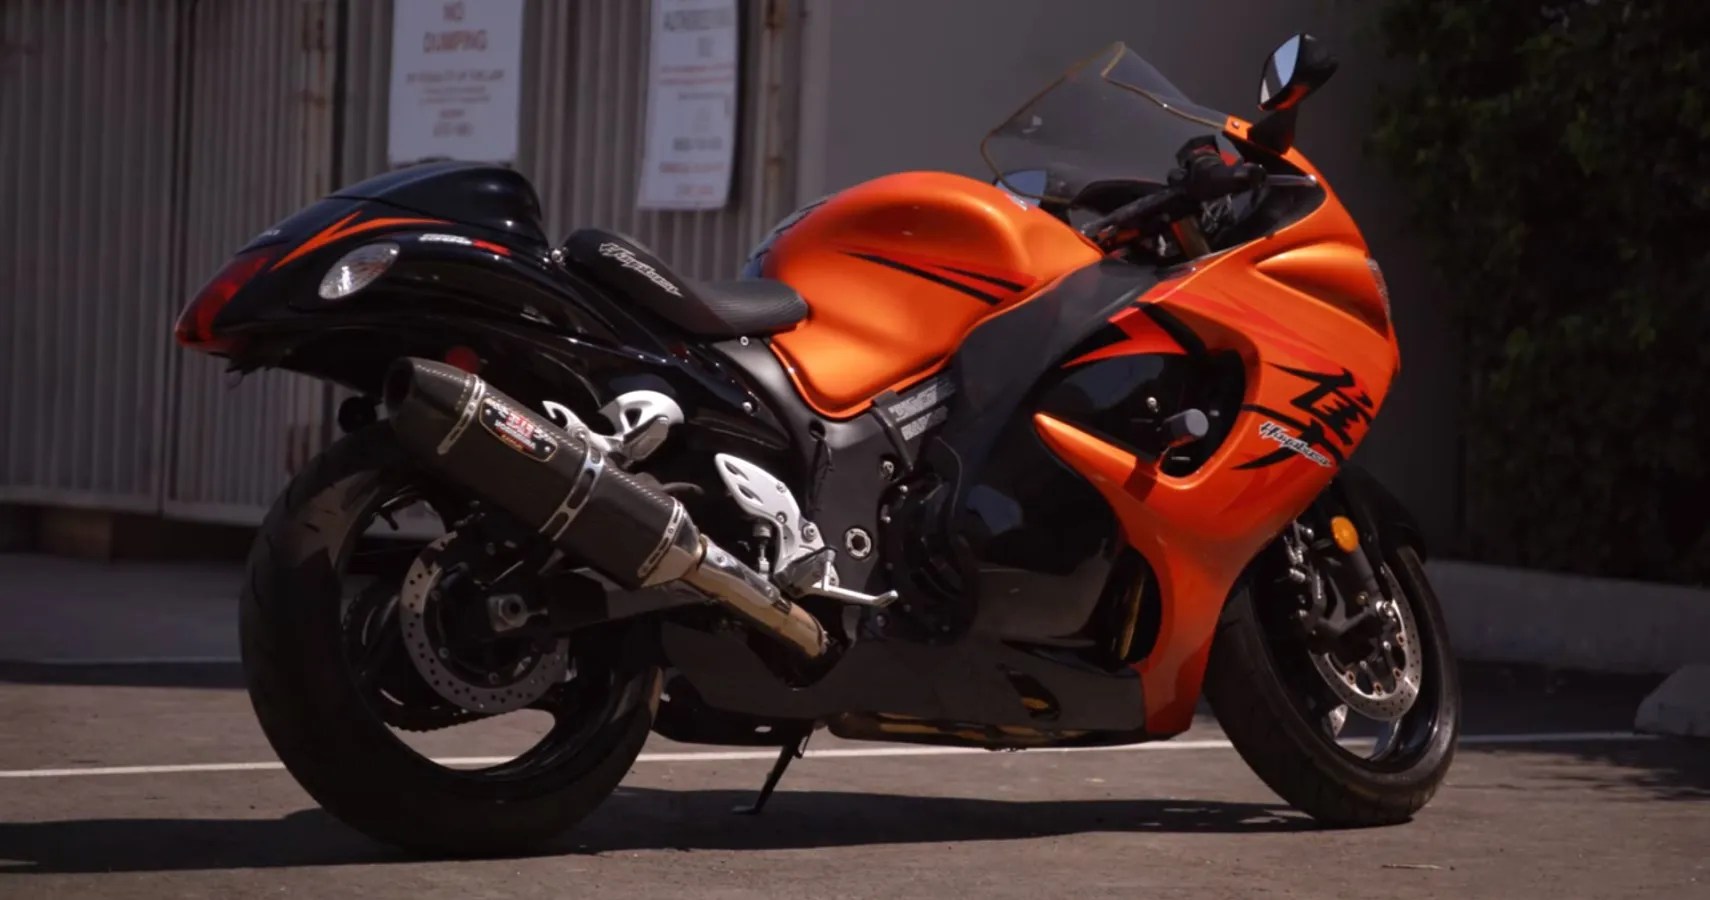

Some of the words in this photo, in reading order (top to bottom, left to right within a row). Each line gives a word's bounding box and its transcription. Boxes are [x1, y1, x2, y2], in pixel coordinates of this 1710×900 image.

[443, 3, 465, 21] NO
[424, 29, 487, 52] DUMPING
[599, 243, 684, 297] Hayabusa
[1259, 421, 1333, 467] Hayabusa
